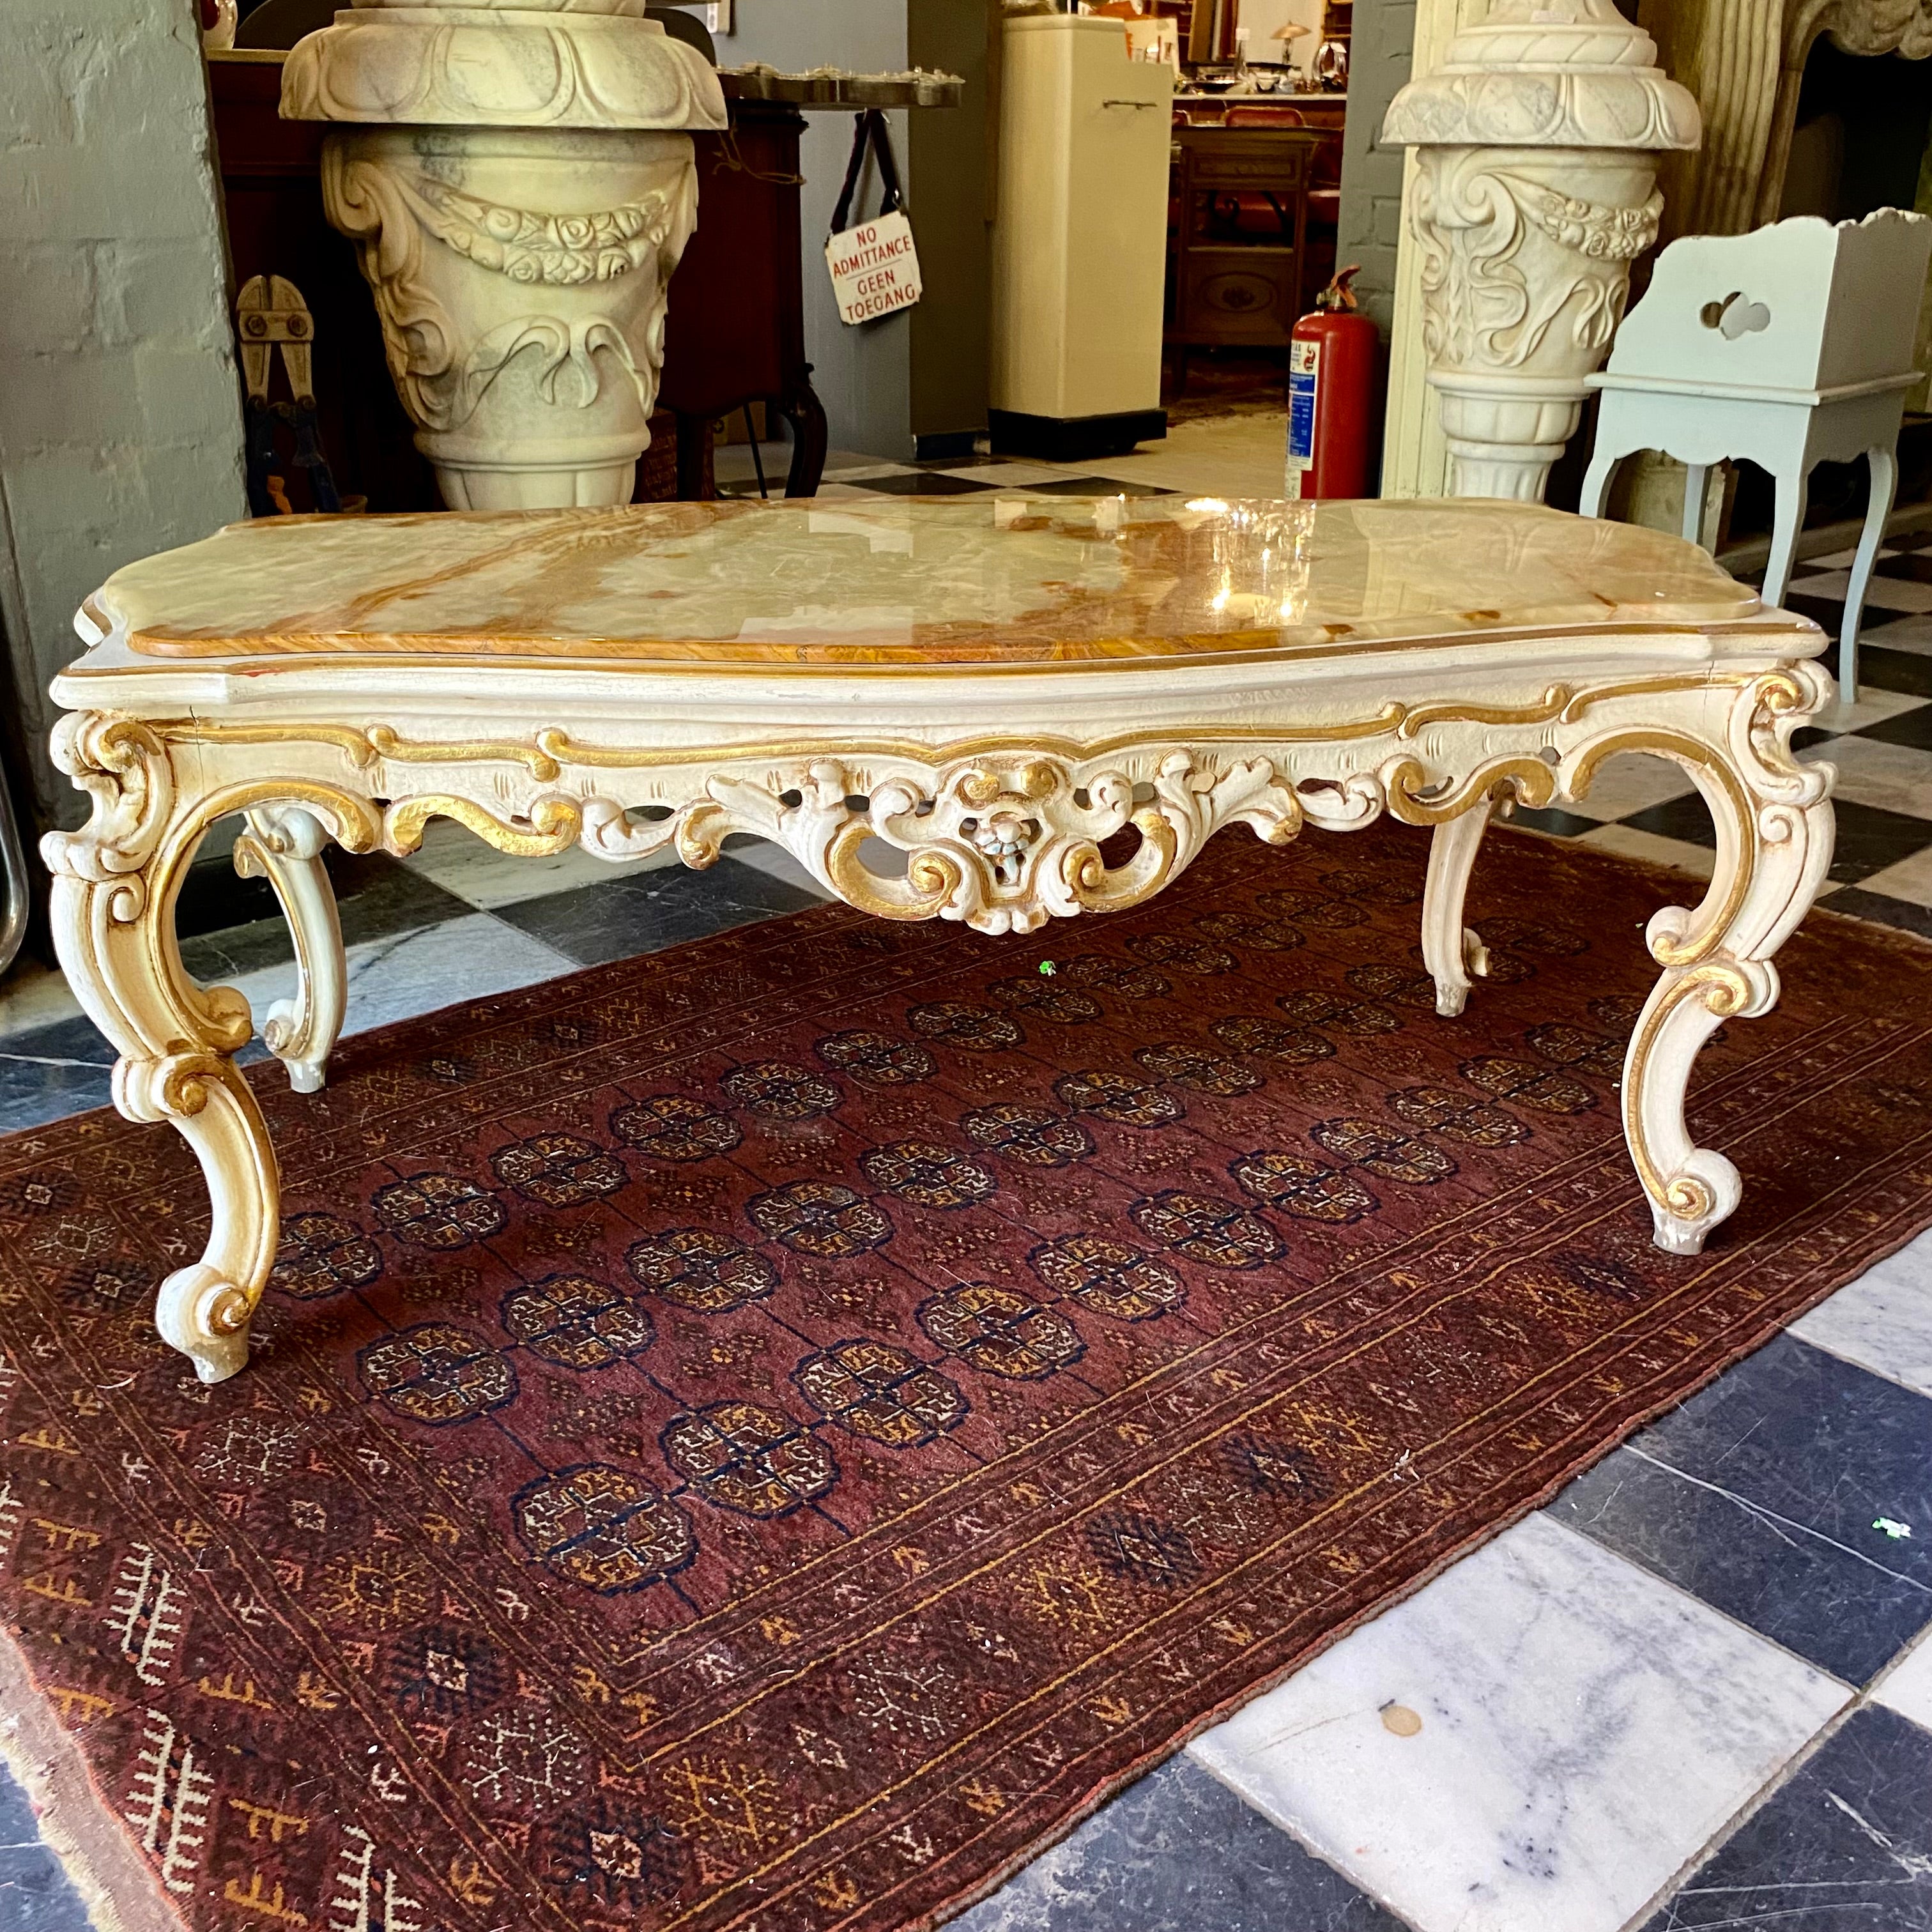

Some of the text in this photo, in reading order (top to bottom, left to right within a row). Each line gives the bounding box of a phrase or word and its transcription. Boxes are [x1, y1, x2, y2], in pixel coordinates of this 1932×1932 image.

[856, 227, 877, 247] NO
[833, 235, 911, 279] ADMITTANCE
[857, 269, 895, 295] GEEN
[845, 284, 916, 321] TOEGANG
